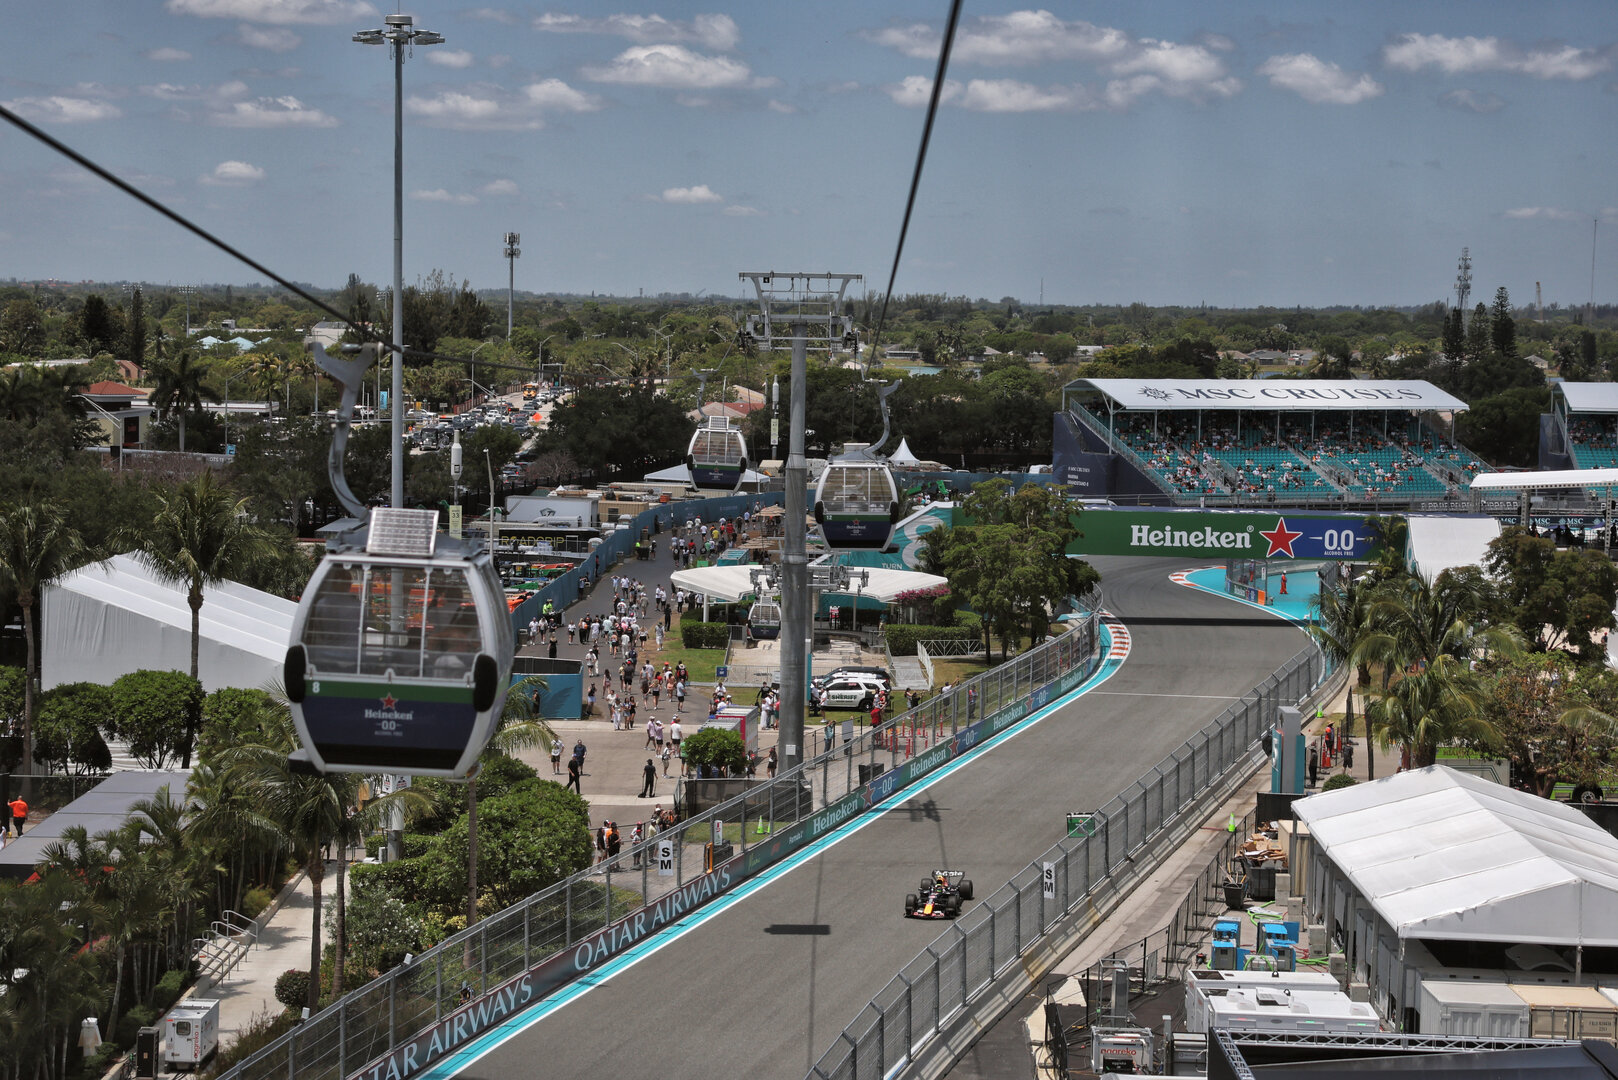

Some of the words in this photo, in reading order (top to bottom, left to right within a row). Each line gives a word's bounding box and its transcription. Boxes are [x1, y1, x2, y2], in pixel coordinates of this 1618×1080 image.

[1174, 388, 1255, 400] MSC
[1260, 388, 1423, 401] CRUISES
[1130, 525, 1252, 549] Heineken
[1324, 529, 1354, 551] 0.0
[312, 681, 320, 693] 8
[364, 709, 413, 720] Heineken
[993, 705, 1023, 731] Heineken
[909, 748, 947, 778] Heineken
[813, 799, 859, 835] Heineken
[574, 911, 647, 971] QATAR
[652, 864, 731, 929] AIRWAYS
[358, 1042, 420, 1080] TAR
[426, 974, 532, 1062] AIRWAYS
